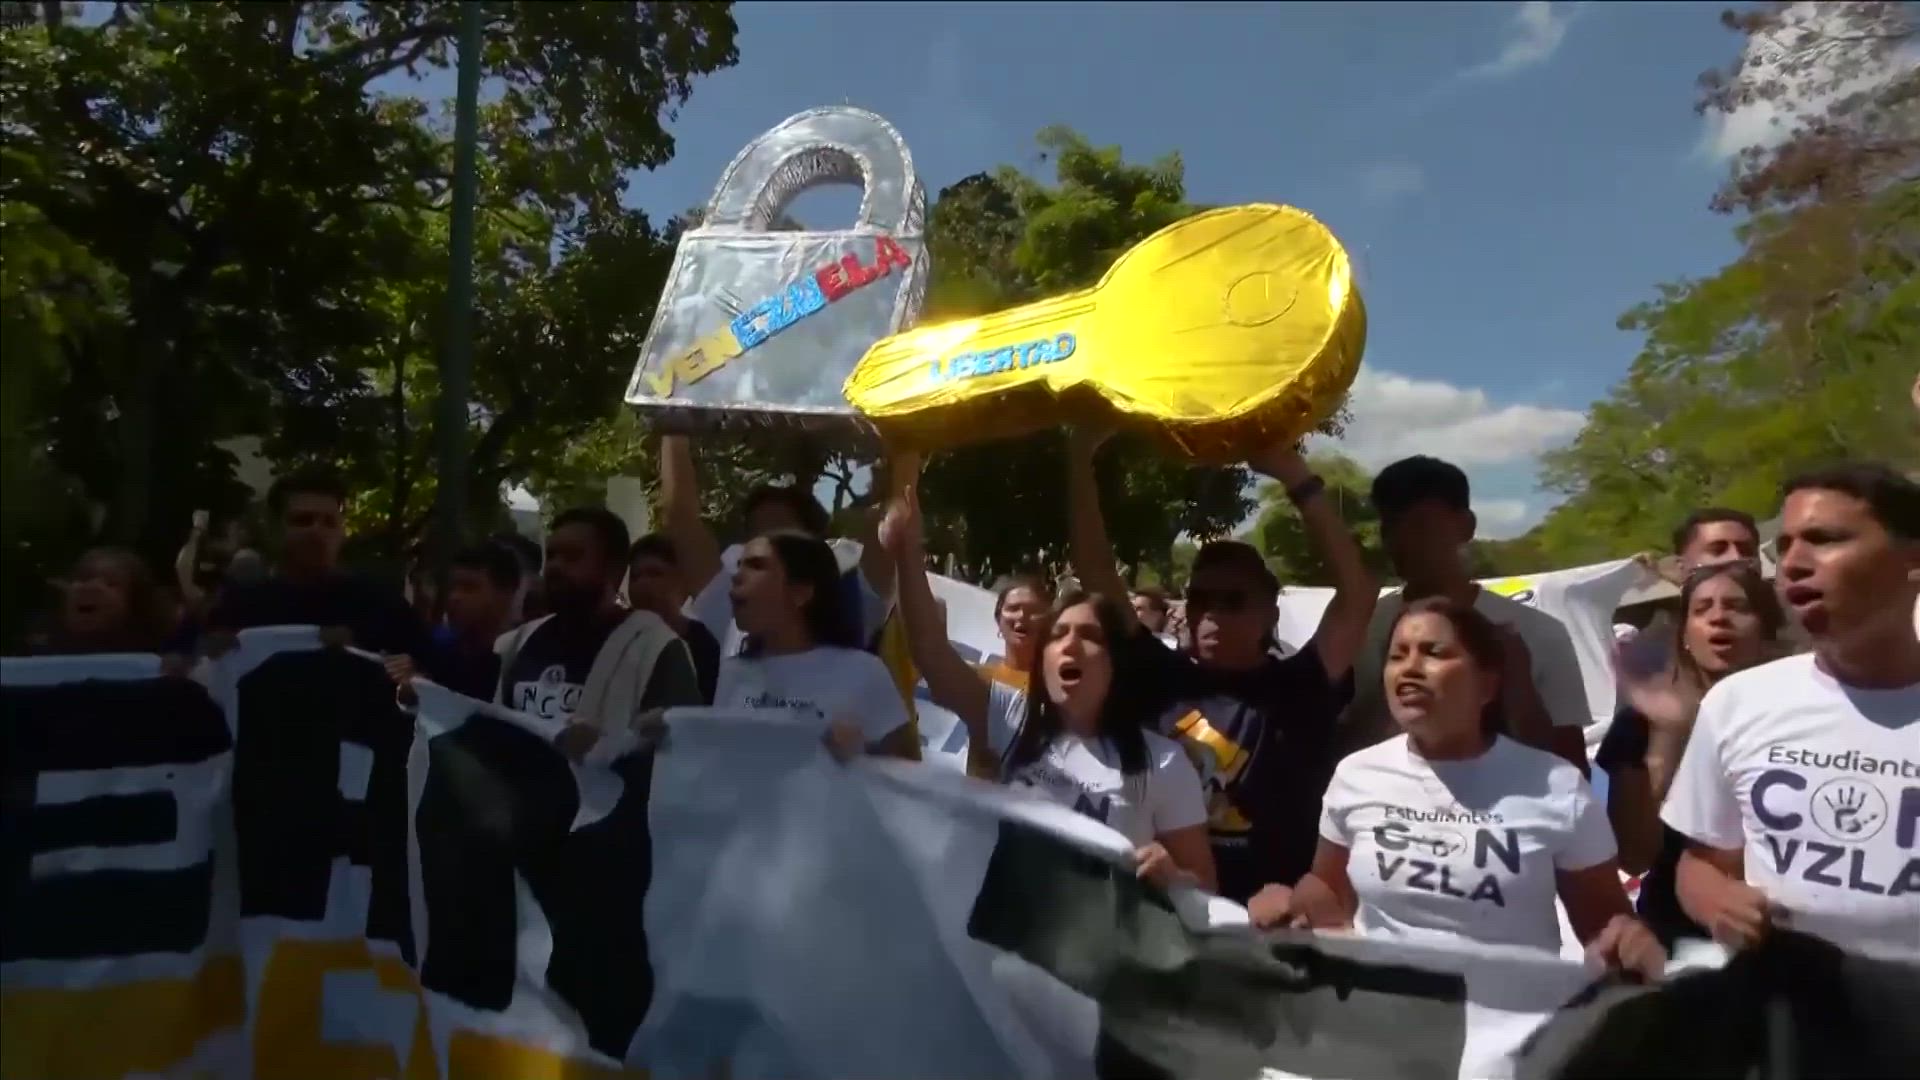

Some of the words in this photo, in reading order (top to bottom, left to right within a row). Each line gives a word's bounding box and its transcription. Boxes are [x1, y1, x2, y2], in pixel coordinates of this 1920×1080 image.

[644, 234, 912, 399] VENEZUELA
[929, 333, 1076, 384] LIBERTAD
[1384, 805, 1504, 824] Estudiantes
[1375, 850, 1505, 908] VZLA
